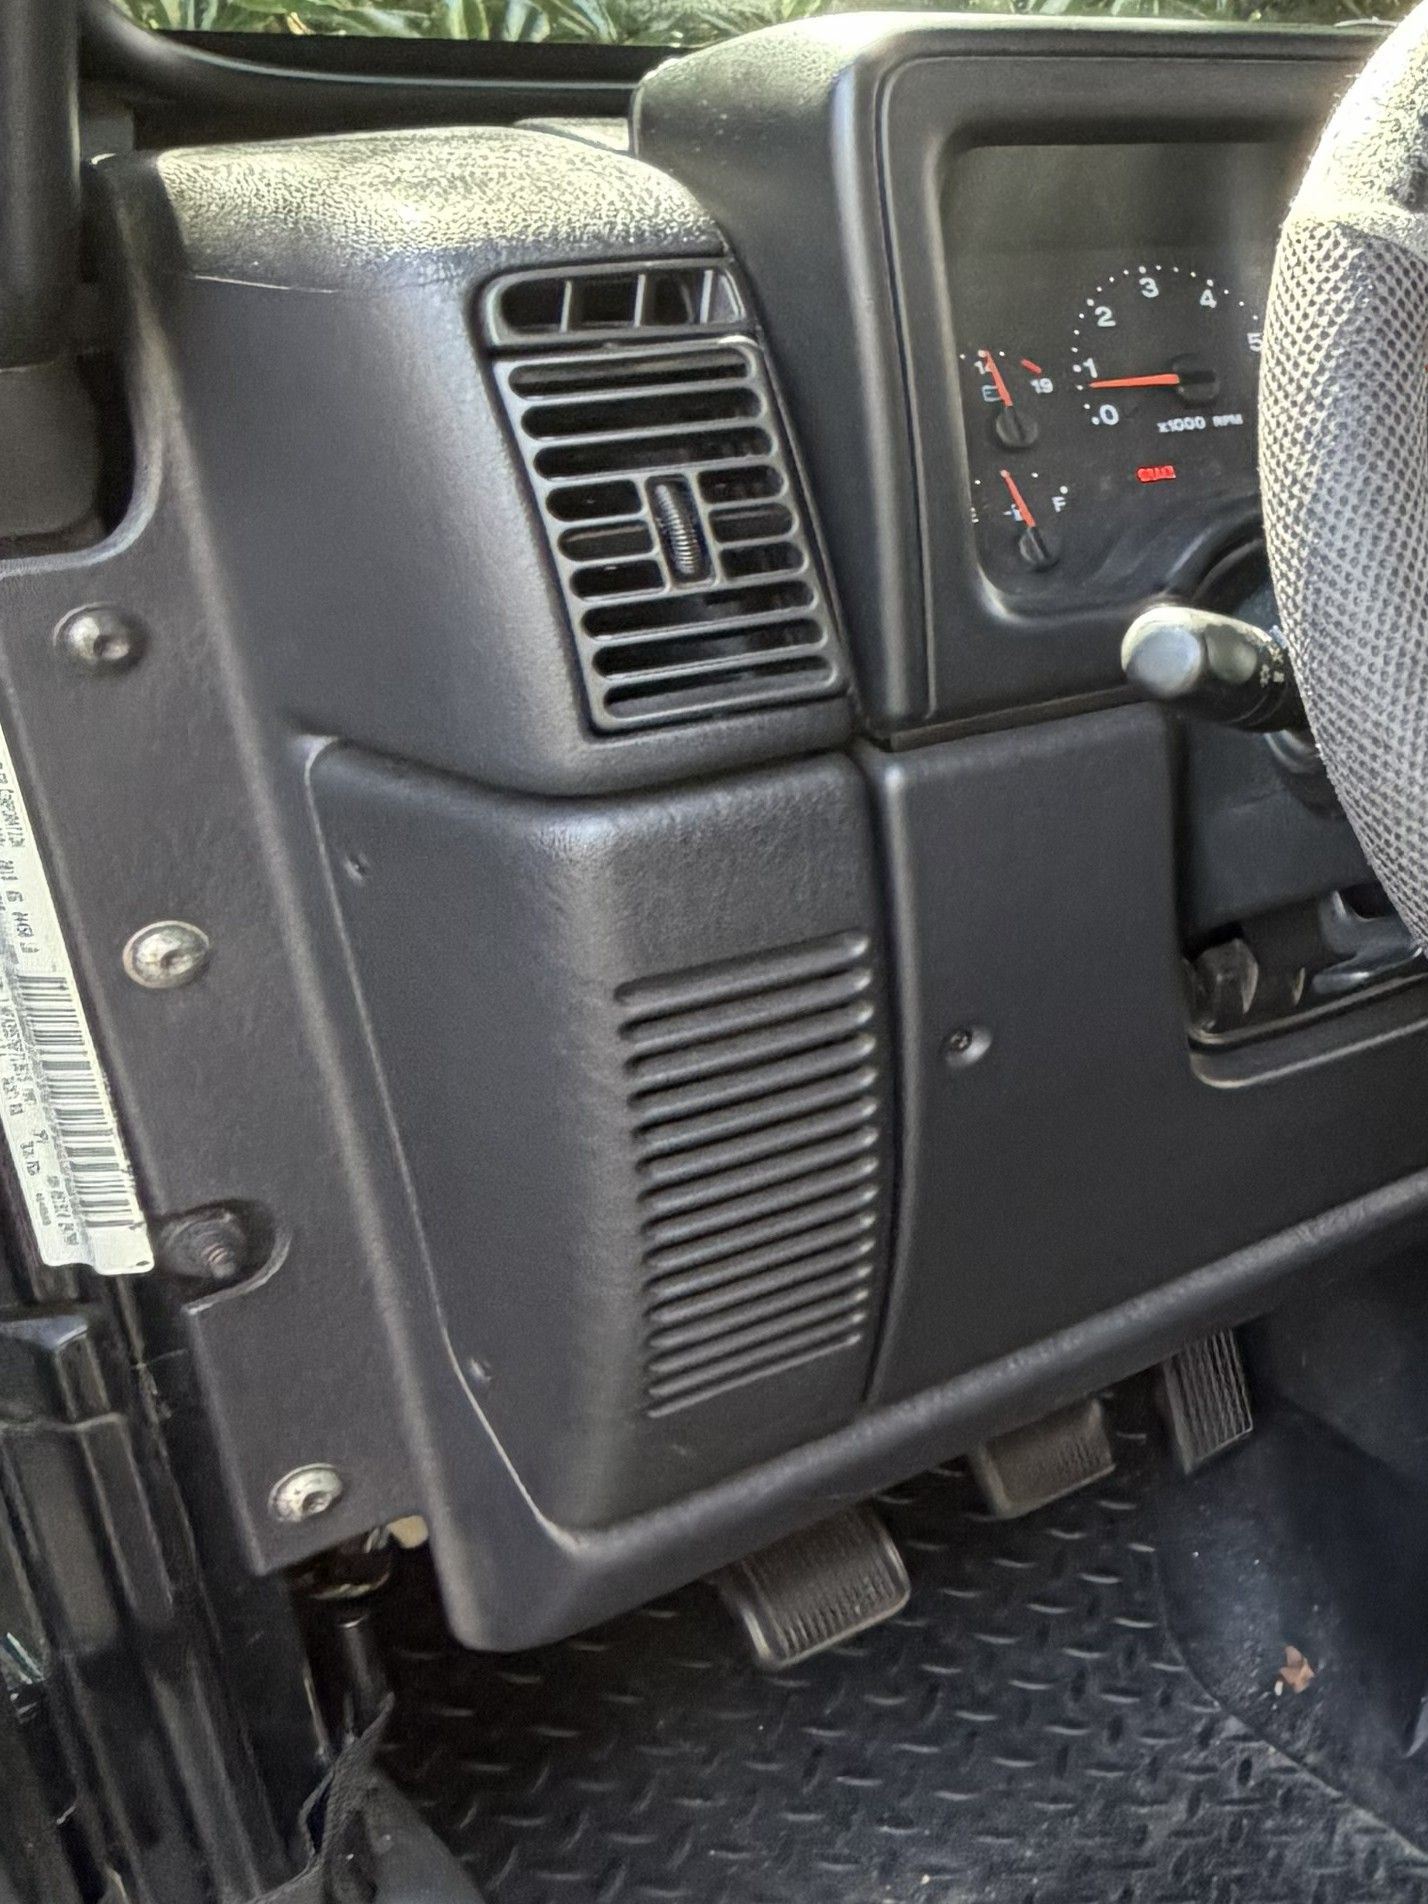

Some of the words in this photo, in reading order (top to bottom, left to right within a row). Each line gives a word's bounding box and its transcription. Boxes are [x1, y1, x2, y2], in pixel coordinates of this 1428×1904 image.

[1139, 277, 1159, 298] 3
[1200, 289, 1217, 309] 4
[1095, 306, 1116, 327] 2
[1247, 332, 1263, 352] 5
[1083, 358, 1098, 378] 1
[1031, 378, 1053, 394] 19
[1099, 404, 1119, 425] 0
[1052, 496, 1066, 512] F
